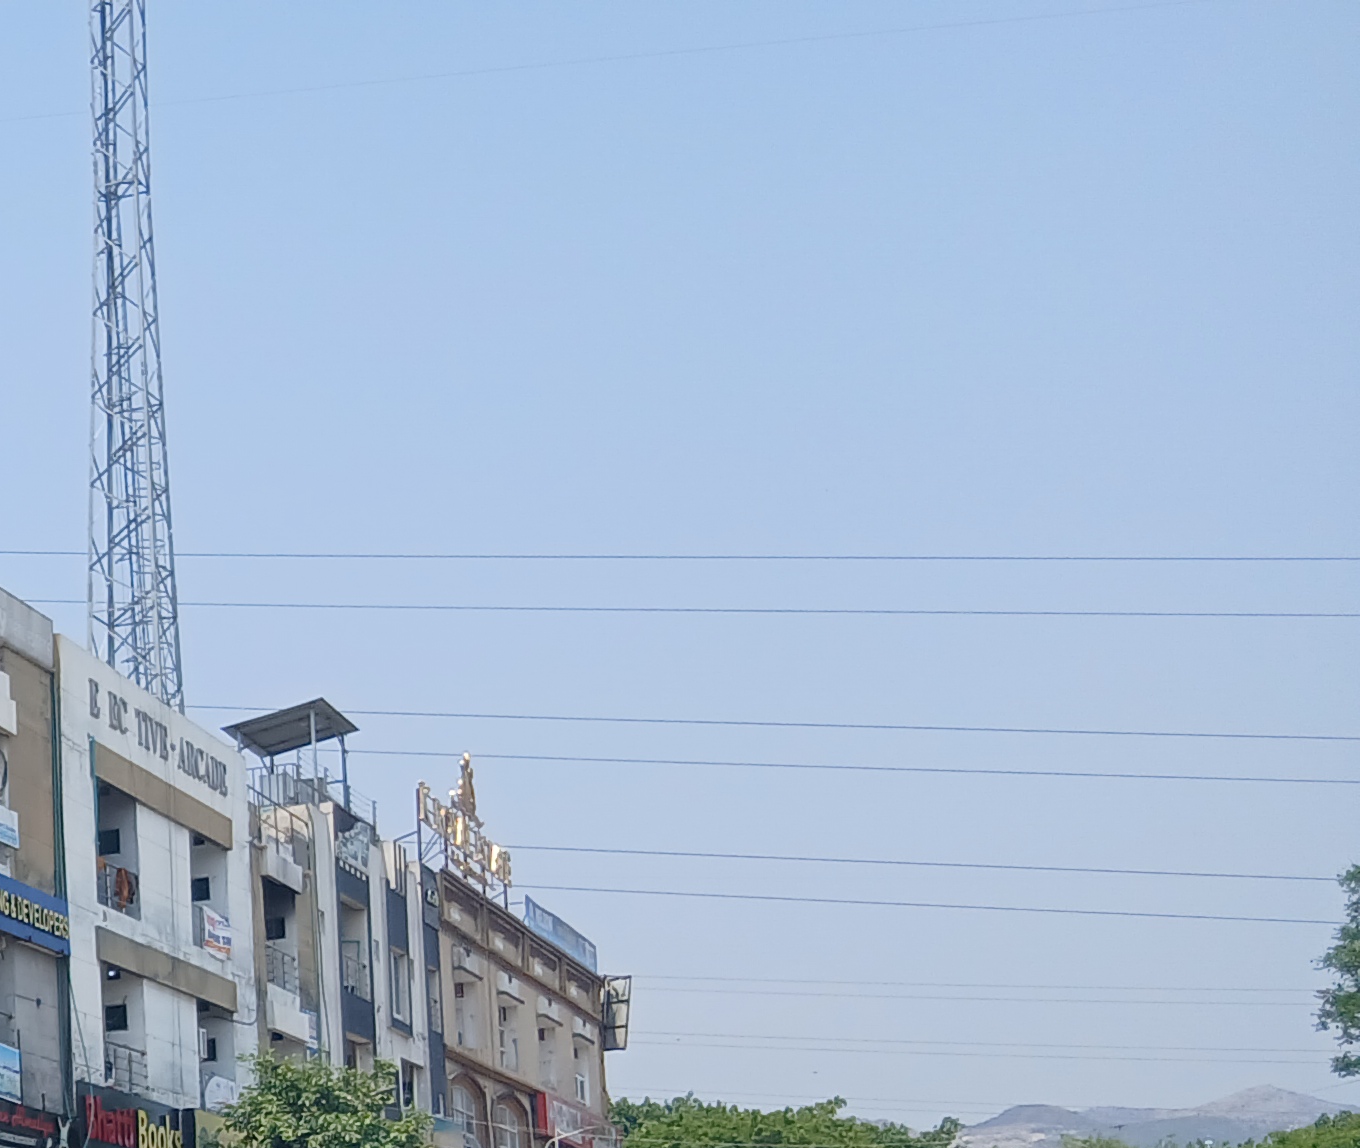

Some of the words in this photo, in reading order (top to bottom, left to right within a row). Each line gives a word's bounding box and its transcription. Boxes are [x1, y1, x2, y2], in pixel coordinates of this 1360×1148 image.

[10, 893, 17, 918] &
[18, 895, 69, 940] DEVELOPERS
[84, 1093, 136, 1148] Bhatti
